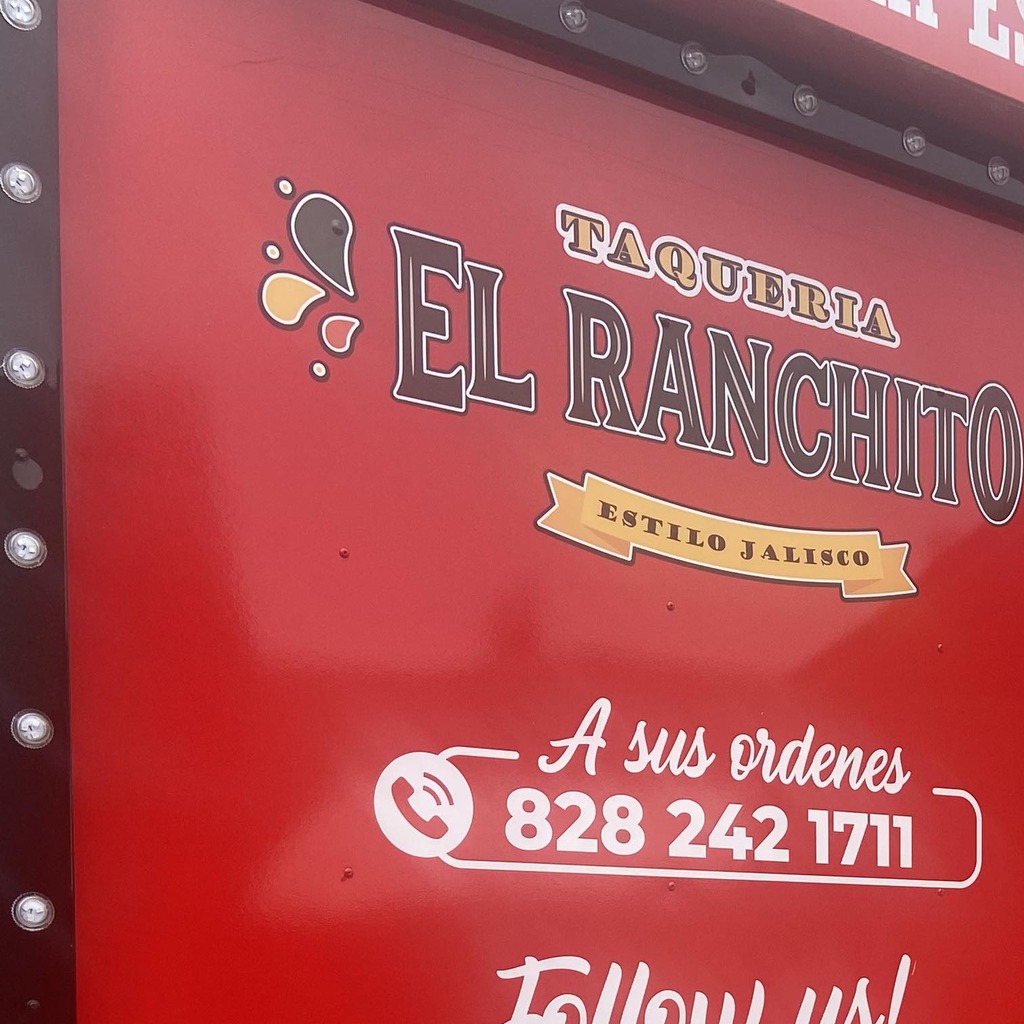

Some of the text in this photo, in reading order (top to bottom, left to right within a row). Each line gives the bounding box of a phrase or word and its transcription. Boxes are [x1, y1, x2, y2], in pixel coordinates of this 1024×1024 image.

[556, 204, 900, 347] TAQUERIA
[389, 224, 1024, 526] EL RANCHITO
[598, 499, 870, 568] ESTILO JALISCO
[538, 697, 911, 794] A sus ordenes
[505, 788, 912, 868] 828 242 1711
